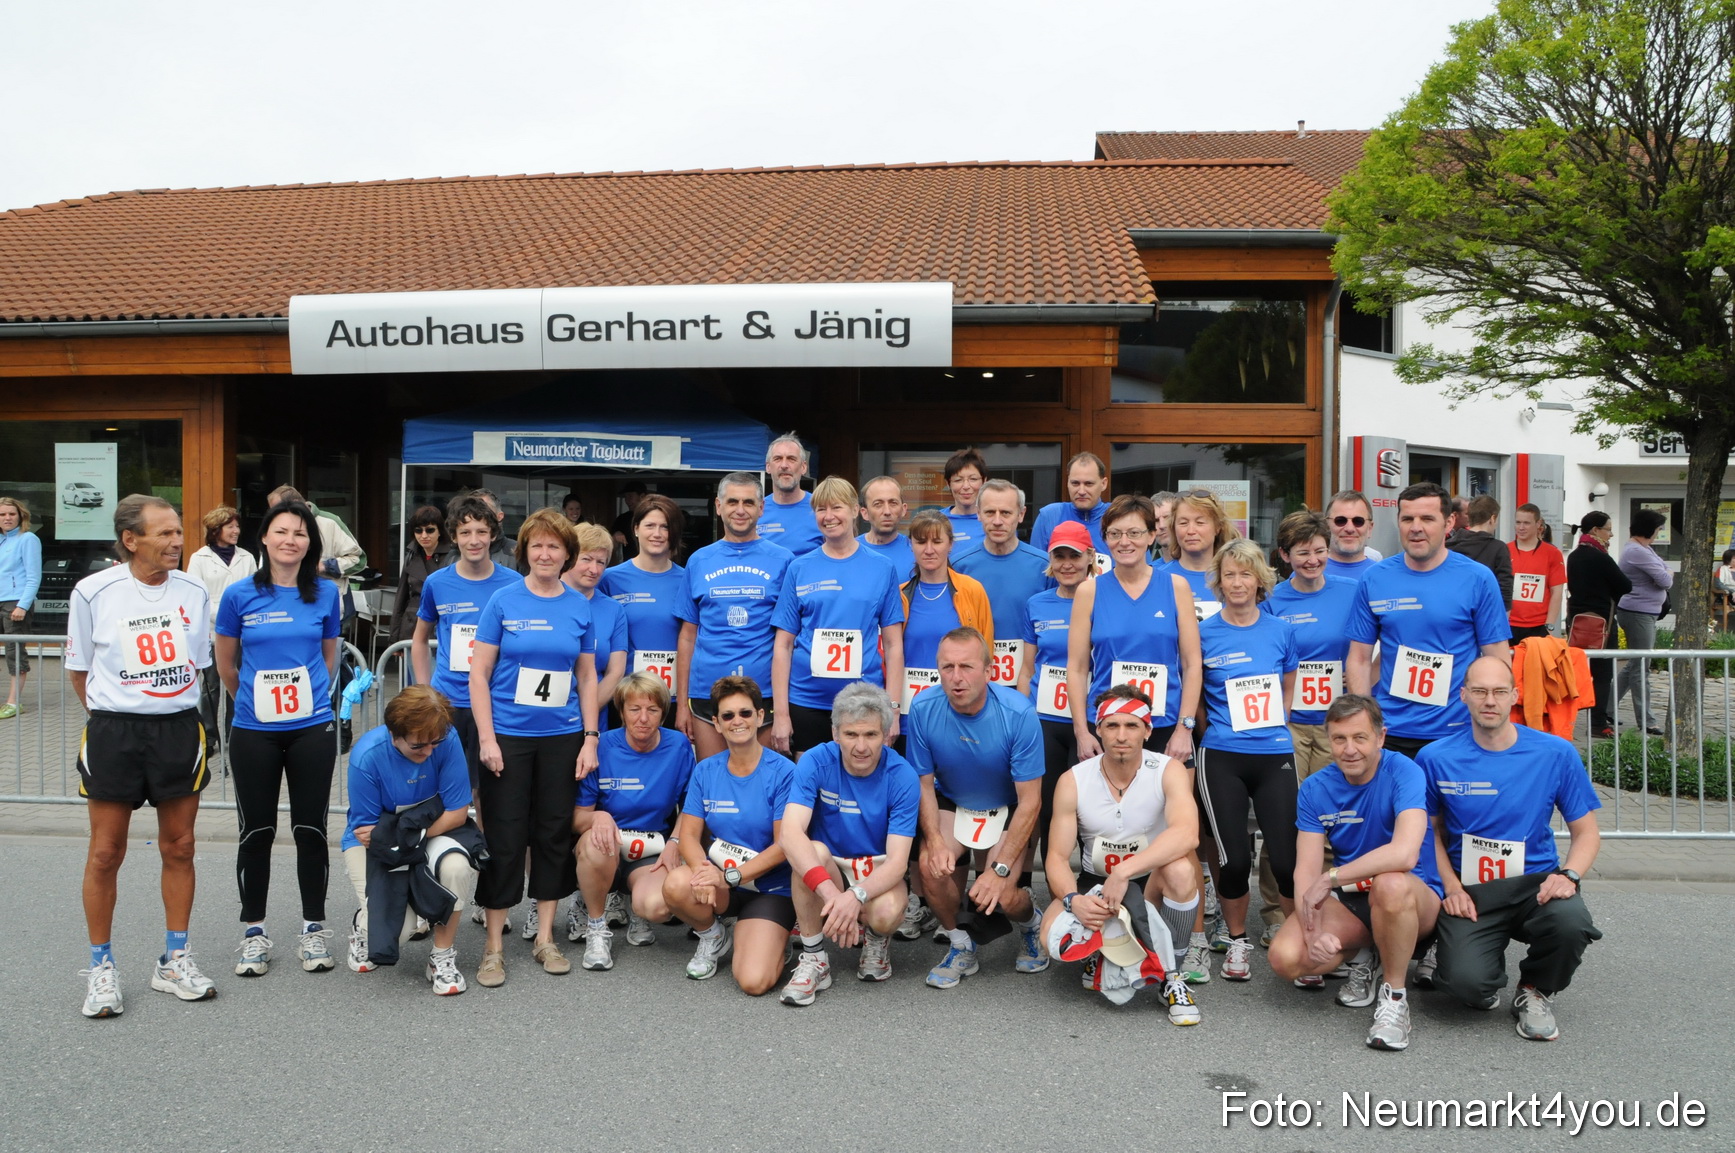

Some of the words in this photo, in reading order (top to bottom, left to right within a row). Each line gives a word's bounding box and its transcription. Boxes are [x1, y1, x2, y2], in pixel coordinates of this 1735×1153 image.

[326, 316, 524, 348] Autohaus
[546, 311, 723, 342] Gerhart
[742, 310, 776, 340] &
[794, 308, 911, 348] Jänig
[512, 440, 588, 459] Neumarkter
[590, 442, 645, 461] Tagblatt
[1372, 498, 1398, 507] SEA
[704, 565, 771, 581] funrunners
[1521, 582, 1538, 599] 57
[128, 616, 158, 627] MEYER
[136, 630, 176, 665] 86
[827, 643, 851, 672] 21
[1406, 650, 1431, 662] MEYER
[1048, 668, 1067, 676] MEYE
[1122, 664, 1148, 672] MEYER
[534, 673, 551, 702] 4
[1235, 678, 1261, 688] MEYER
[1302, 677, 1332, 705] 55
[1408, 665, 1435, 697] 16
[271, 684, 299, 714] 13
[1243, 692, 1271, 723] 67
[972, 817, 986, 843] 7
[628, 839, 645, 860] 9
[720, 842, 743, 854] MEYER
[1102, 841, 1128, 849] MEYER
[1472, 838, 1499, 849] MEYER
[1478, 856, 1506, 884] 61
